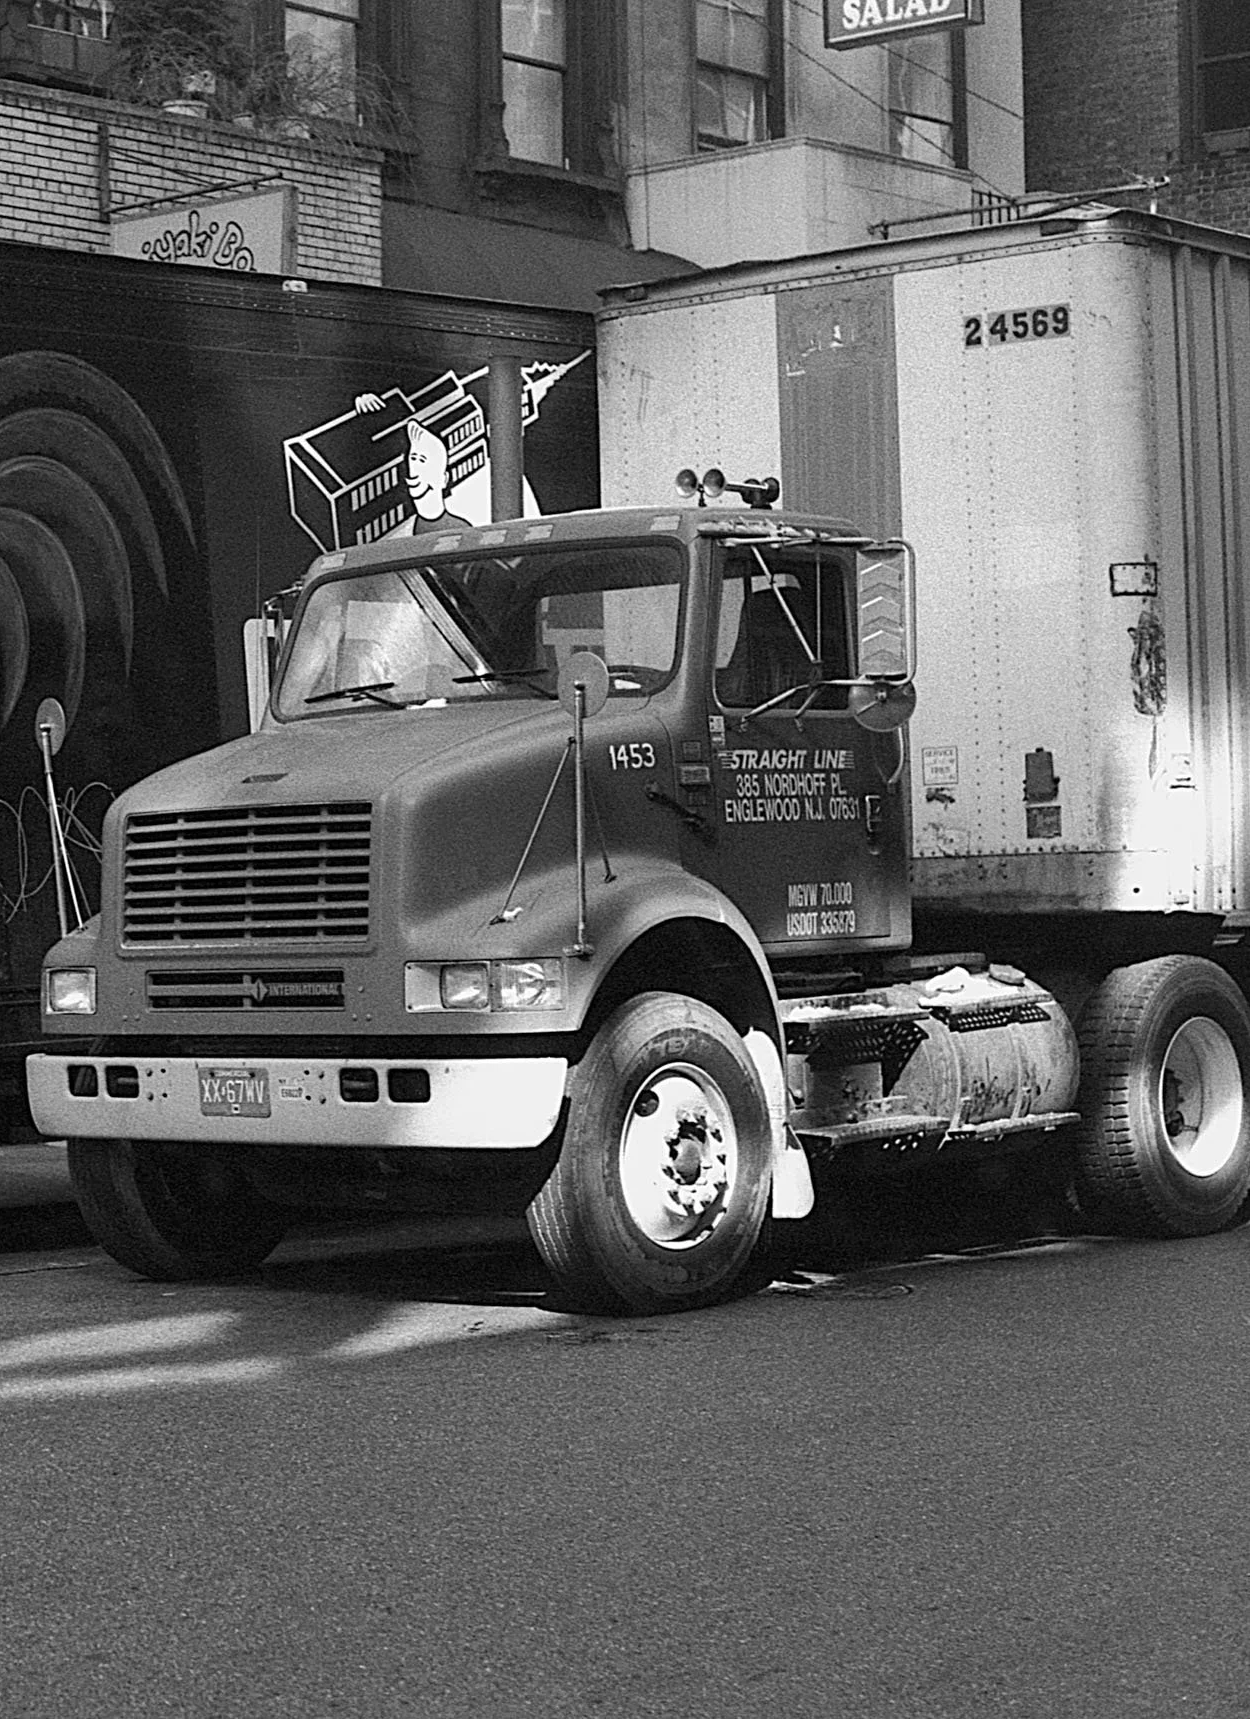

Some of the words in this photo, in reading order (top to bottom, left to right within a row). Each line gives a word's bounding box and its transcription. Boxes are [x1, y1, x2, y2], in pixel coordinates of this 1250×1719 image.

[964, 306, 1070, 347] 24569
[609, 742, 656, 771] 1453
[730, 749, 807, 770] STRAIGHT
[813, 749, 848, 769] LINE
[736, 773, 761, 797] 385
[764, 773, 827, 797] NORDHOFF
[724, 798, 801, 823] ENGLEWOOD
[804, 797, 826, 820] N.J.
[829, 796, 861, 820] 07631
[786, 911, 819, 937] USDOT
